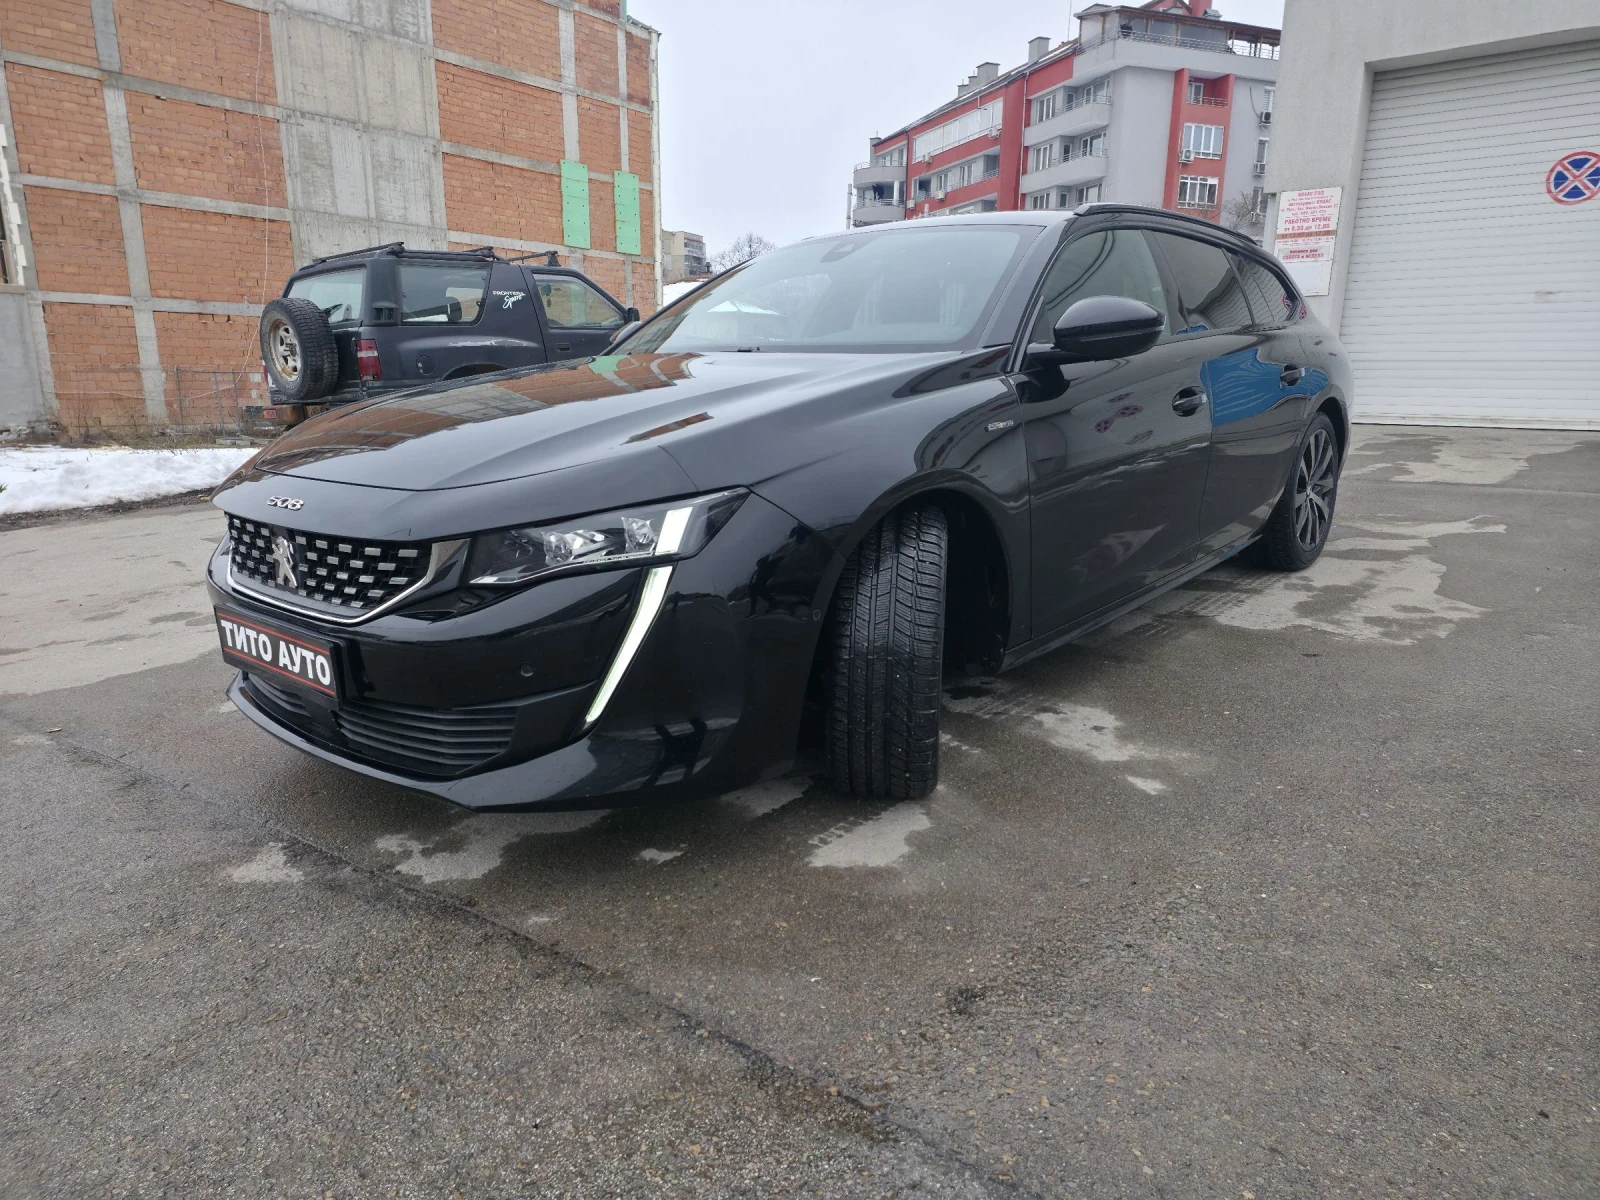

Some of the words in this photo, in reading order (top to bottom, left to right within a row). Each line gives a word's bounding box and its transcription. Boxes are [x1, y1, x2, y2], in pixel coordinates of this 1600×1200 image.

[267, 496, 304, 511] 508
[220, 620, 272, 662] ТИТО
[279, 640, 330, 686] АУТО
